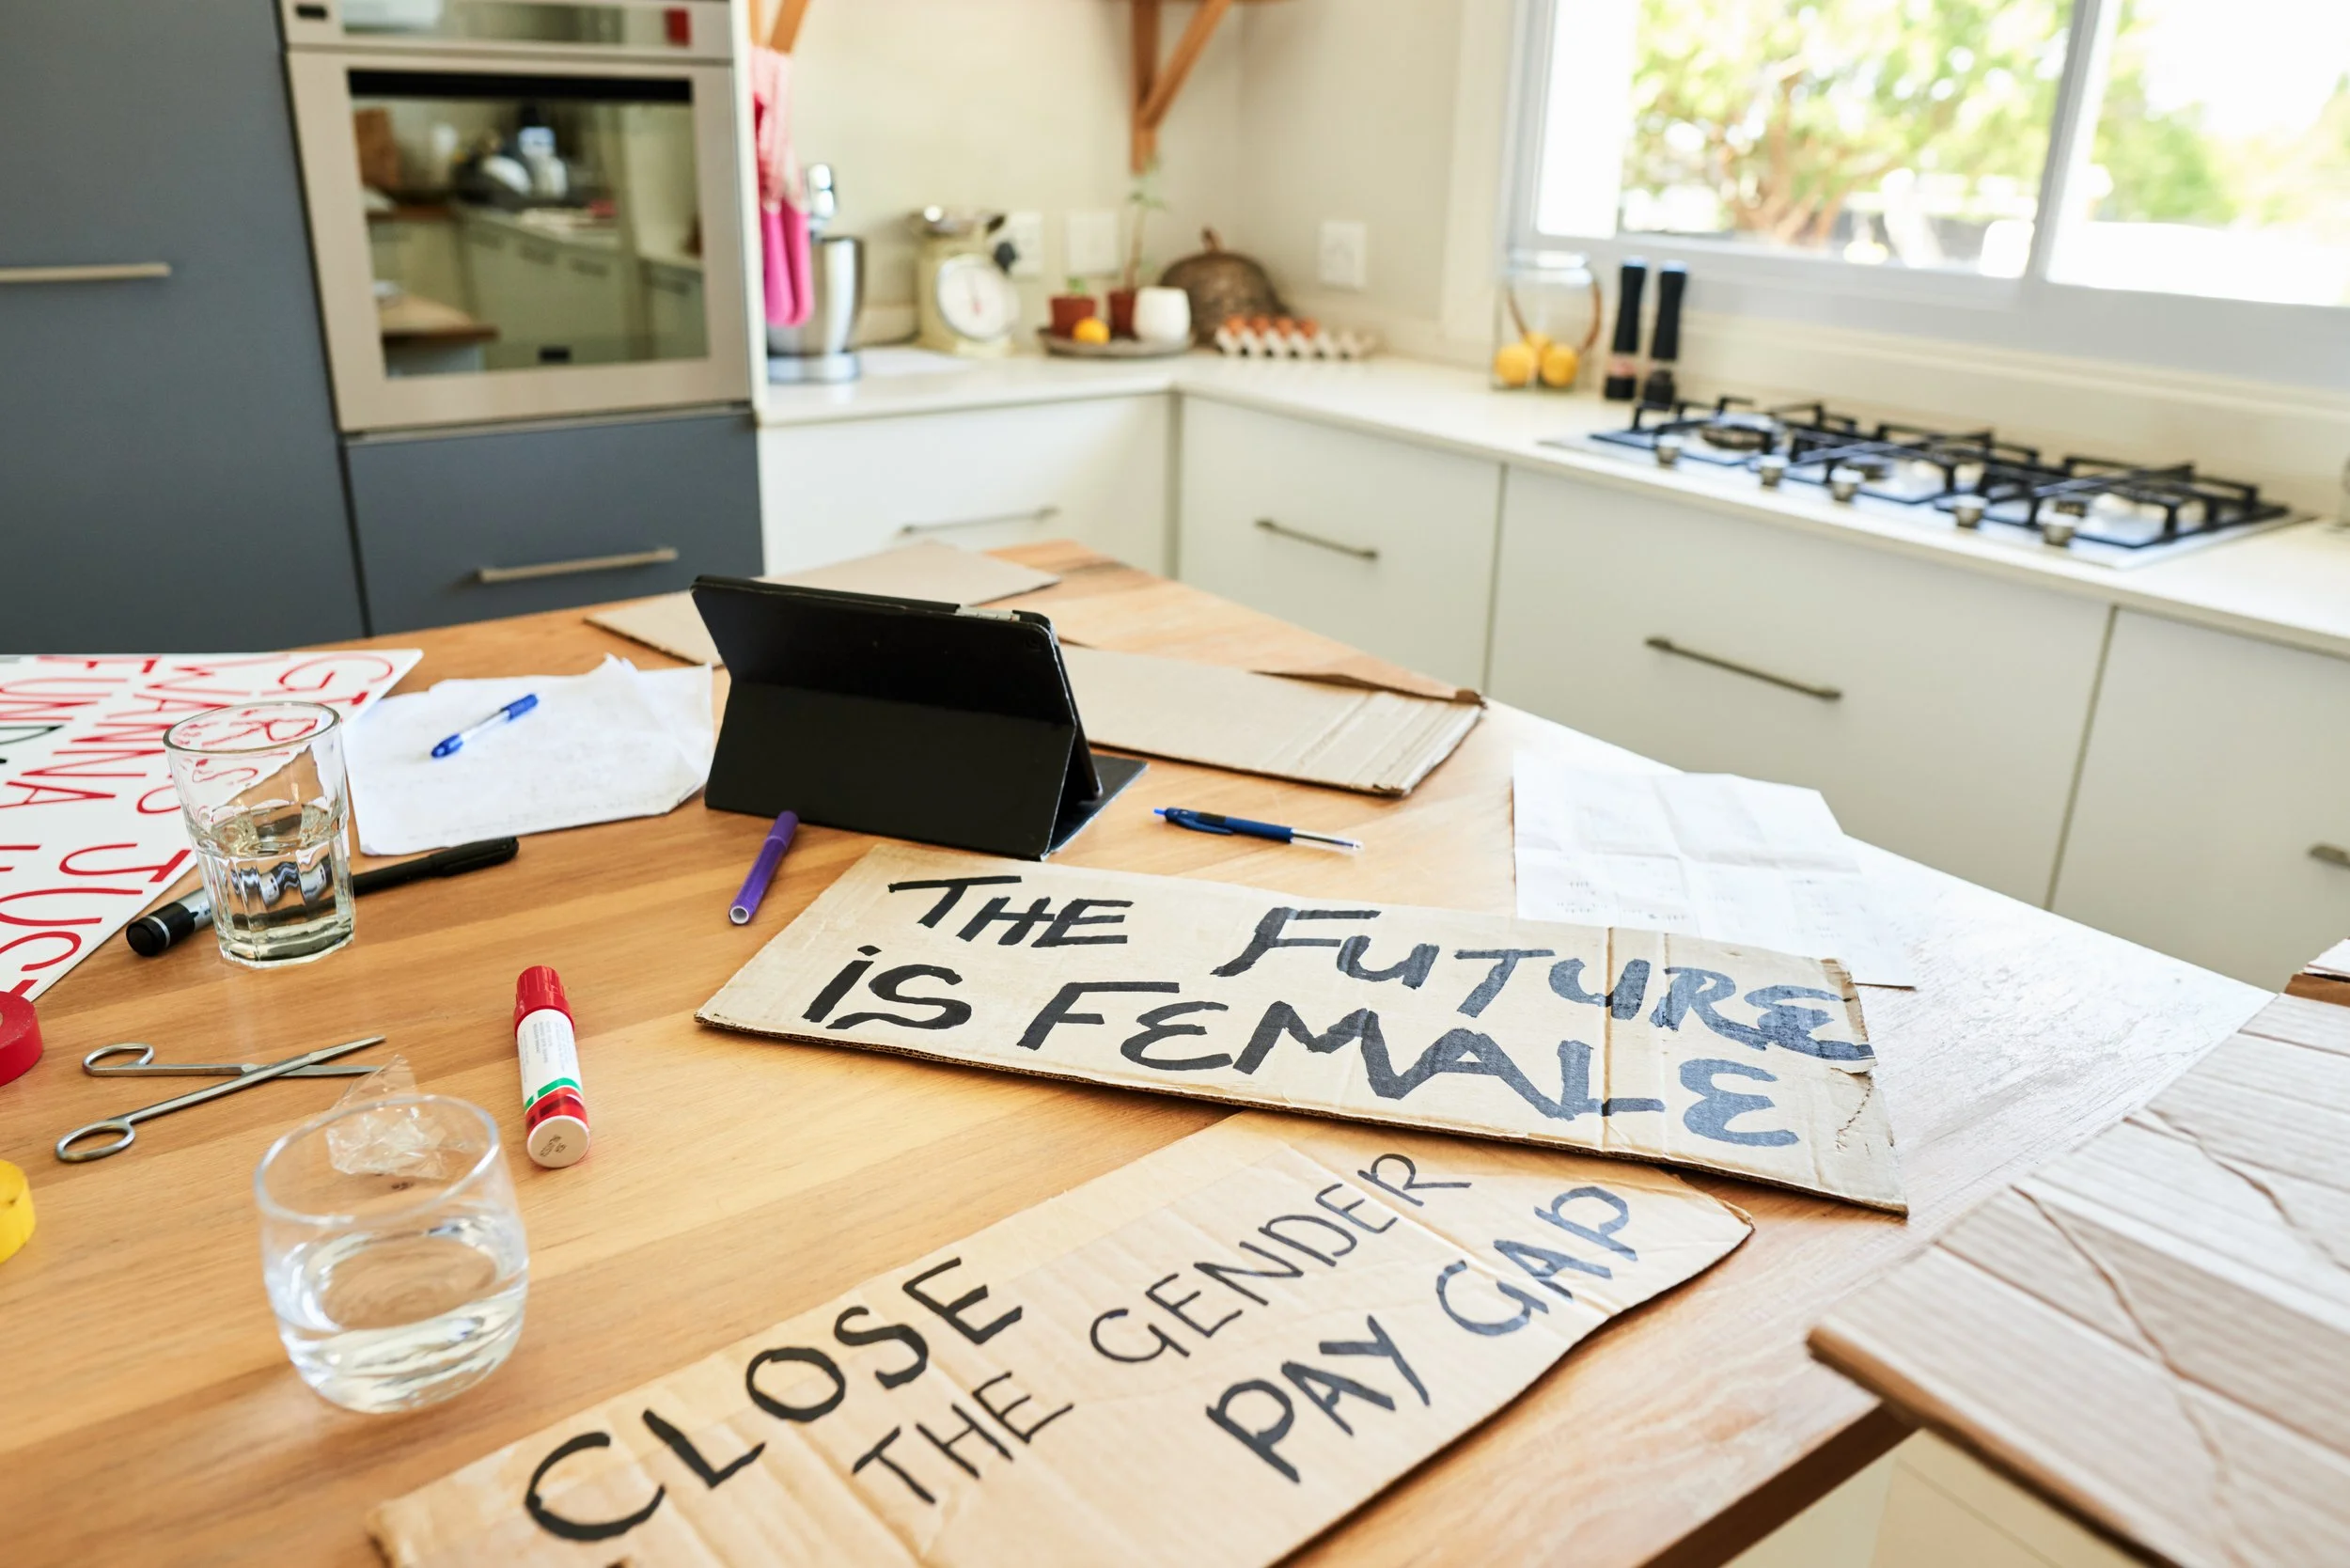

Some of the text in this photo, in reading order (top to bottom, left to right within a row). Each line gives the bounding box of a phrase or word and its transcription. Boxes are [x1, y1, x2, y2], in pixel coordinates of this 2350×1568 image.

[888, 875, 1135, 948] THE
[1211, 906, 1874, 1061] FUTURE
[1016, 981, 1799, 1148] FEMALE
[525, 1257, 1024, 1544] CLOSE
[851, 1153, 1472, 1504] THE GENDER
[1206, 1185, 1639, 1484] PAY GAP
